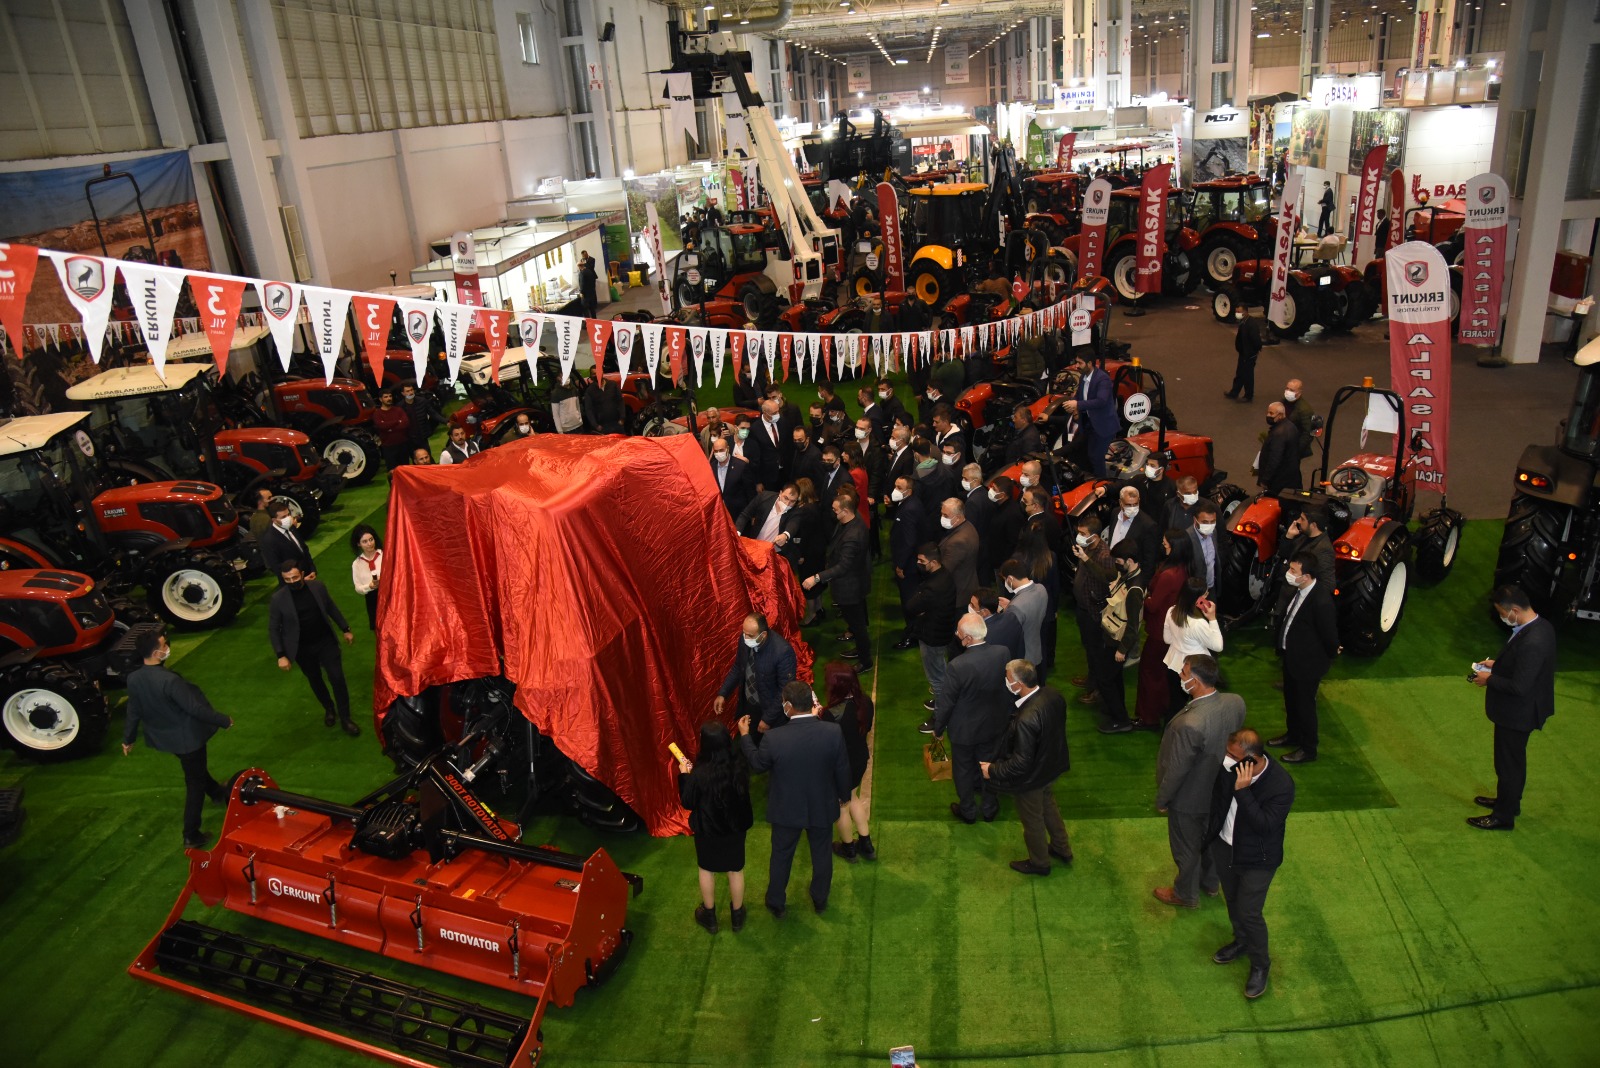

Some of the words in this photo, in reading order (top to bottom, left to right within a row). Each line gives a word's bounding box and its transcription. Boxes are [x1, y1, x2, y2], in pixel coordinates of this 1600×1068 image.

[1331, 86, 1358, 103] BASAK
[1205, 112, 1239, 123] MST
[1434, 183, 1466, 197] BAS
[1360, 167, 1379, 233] BASAK
[1085, 207, 1107, 215] ERKUNT
[1143, 187, 1162, 257] BASAK
[1278, 201, 1294, 283] BASAK
[95, 387, 135, 396] ALPASLAN
[136, 384, 163, 392] GROUP
[1128, 408, 1146, 416] ÜRÜN
[445, 774, 464, 797] 300T
[461, 794, 508, 841] ROTOVATOR
[283, 885, 321, 904] ERKUNT
[439, 927, 500, 953] ROTOVATOR
